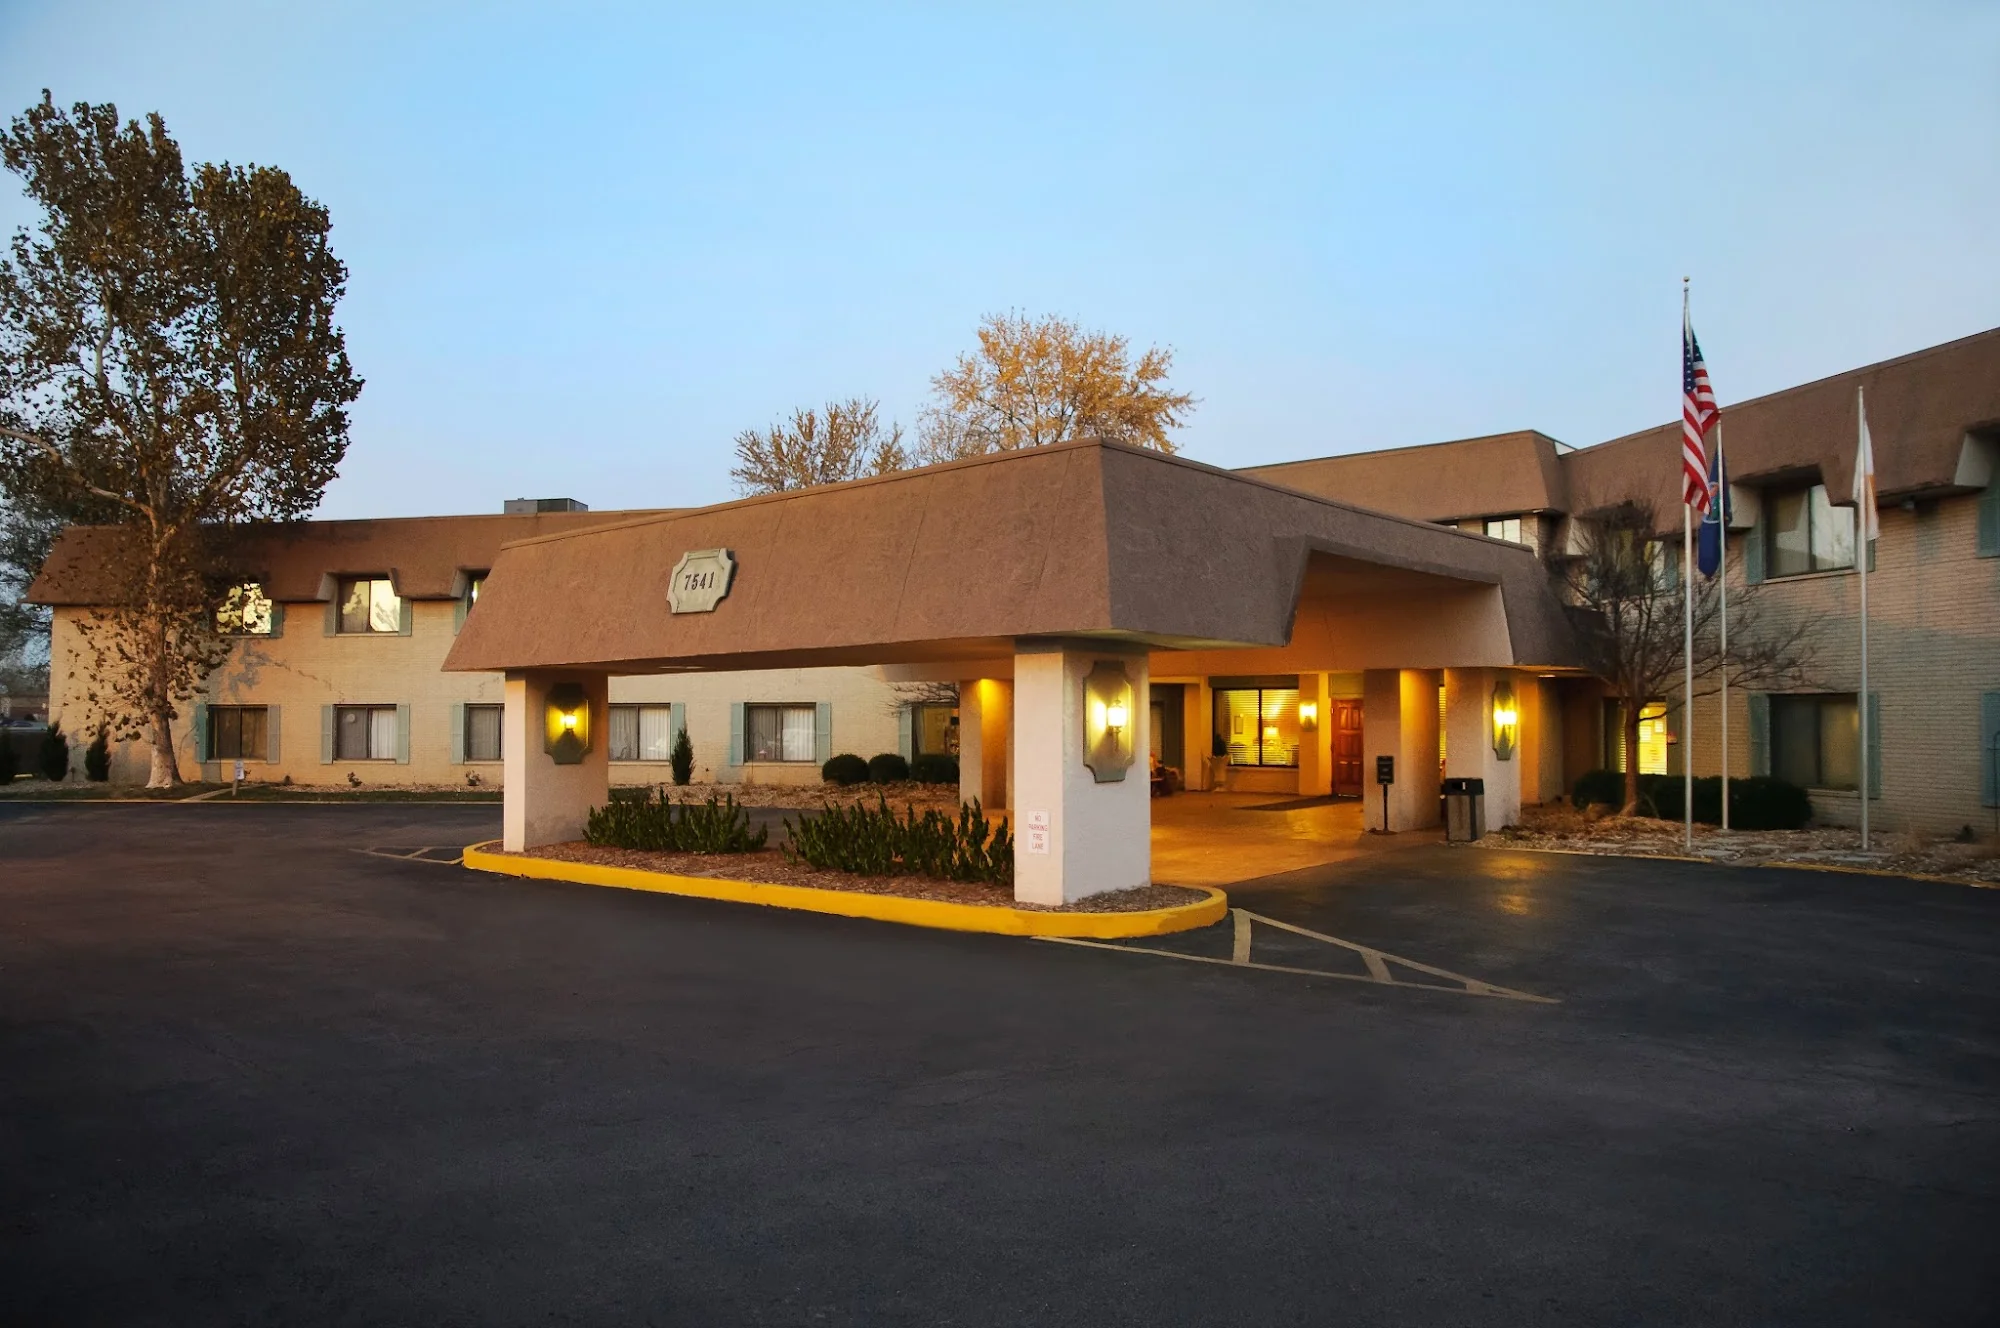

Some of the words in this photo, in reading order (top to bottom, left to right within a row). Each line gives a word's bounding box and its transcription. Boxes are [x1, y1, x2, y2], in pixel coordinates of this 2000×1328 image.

[684, 571, 715, 591] 7541
[1032, 833, 1043, 841] FIRE
[1031, 842, 1044, 850] LANE
